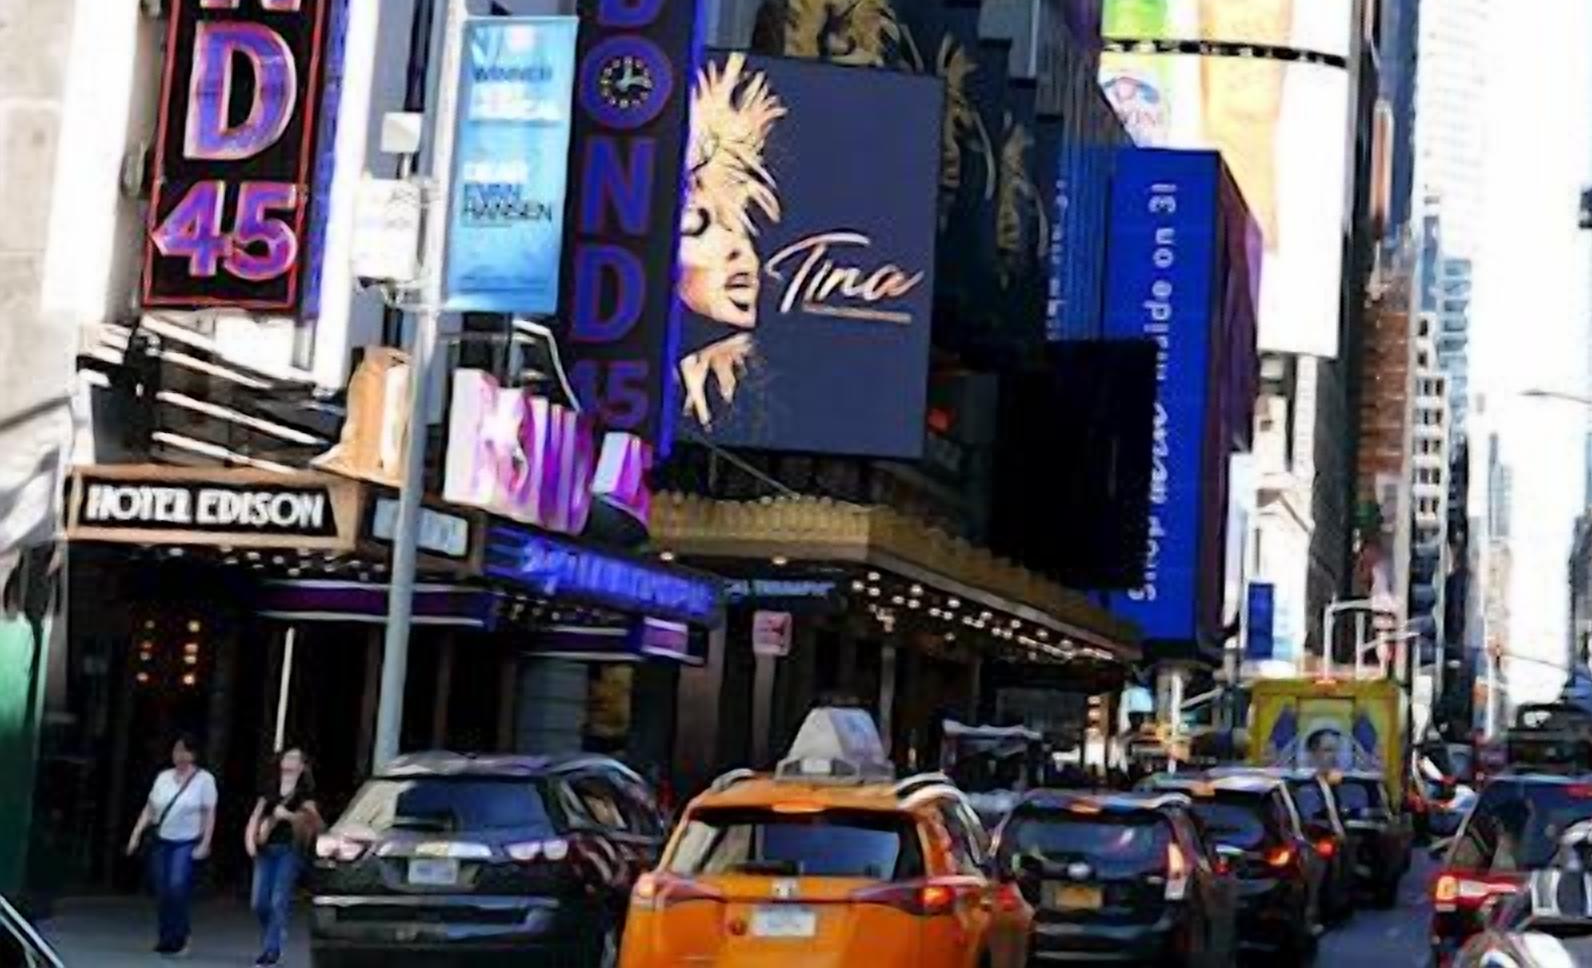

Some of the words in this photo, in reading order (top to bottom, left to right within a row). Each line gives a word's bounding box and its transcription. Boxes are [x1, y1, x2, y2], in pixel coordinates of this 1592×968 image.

[150, 180, 299, 281] 45
[764, 231, 925, 314] Tina
[86, 484, 191, 523] HOTEL
[198, 487, 325, 529] EDISON
